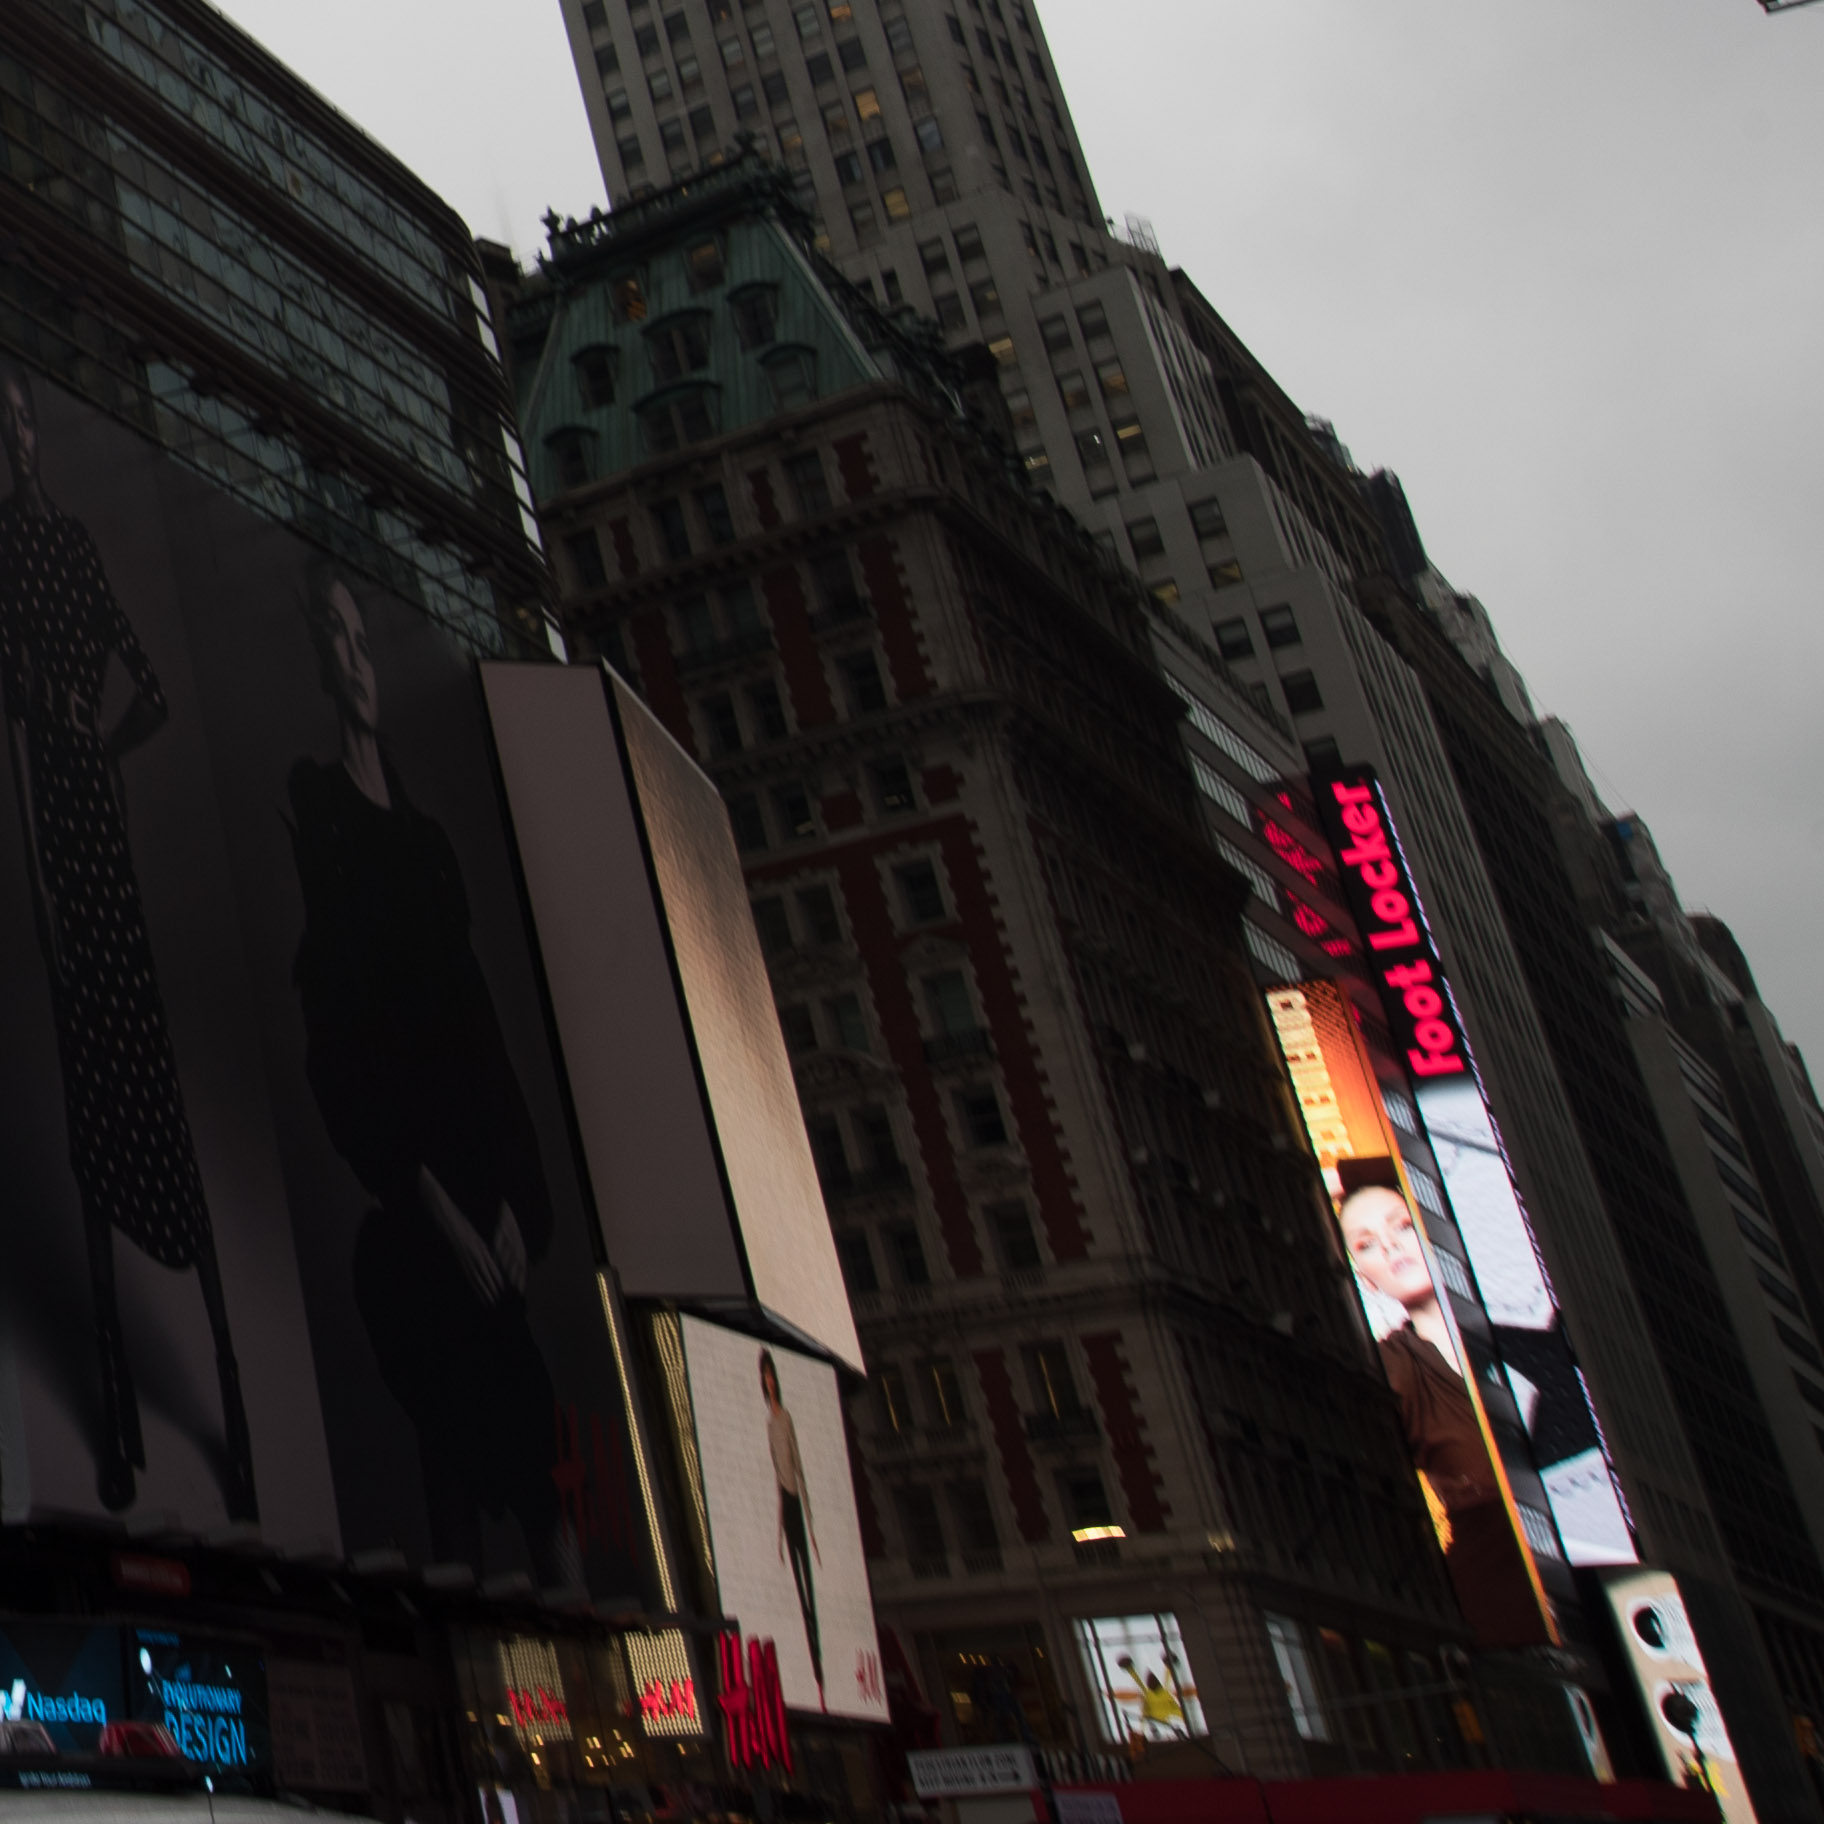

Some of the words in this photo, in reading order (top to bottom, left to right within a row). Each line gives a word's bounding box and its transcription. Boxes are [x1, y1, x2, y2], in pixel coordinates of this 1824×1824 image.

[1331, 779, 1421, 952] Locker
[1383, 959, 1466, 1077] Foot
[27, 1690, 108, 1727] Nasdaq
[164, 1709, 248, 1766] DESIGN
